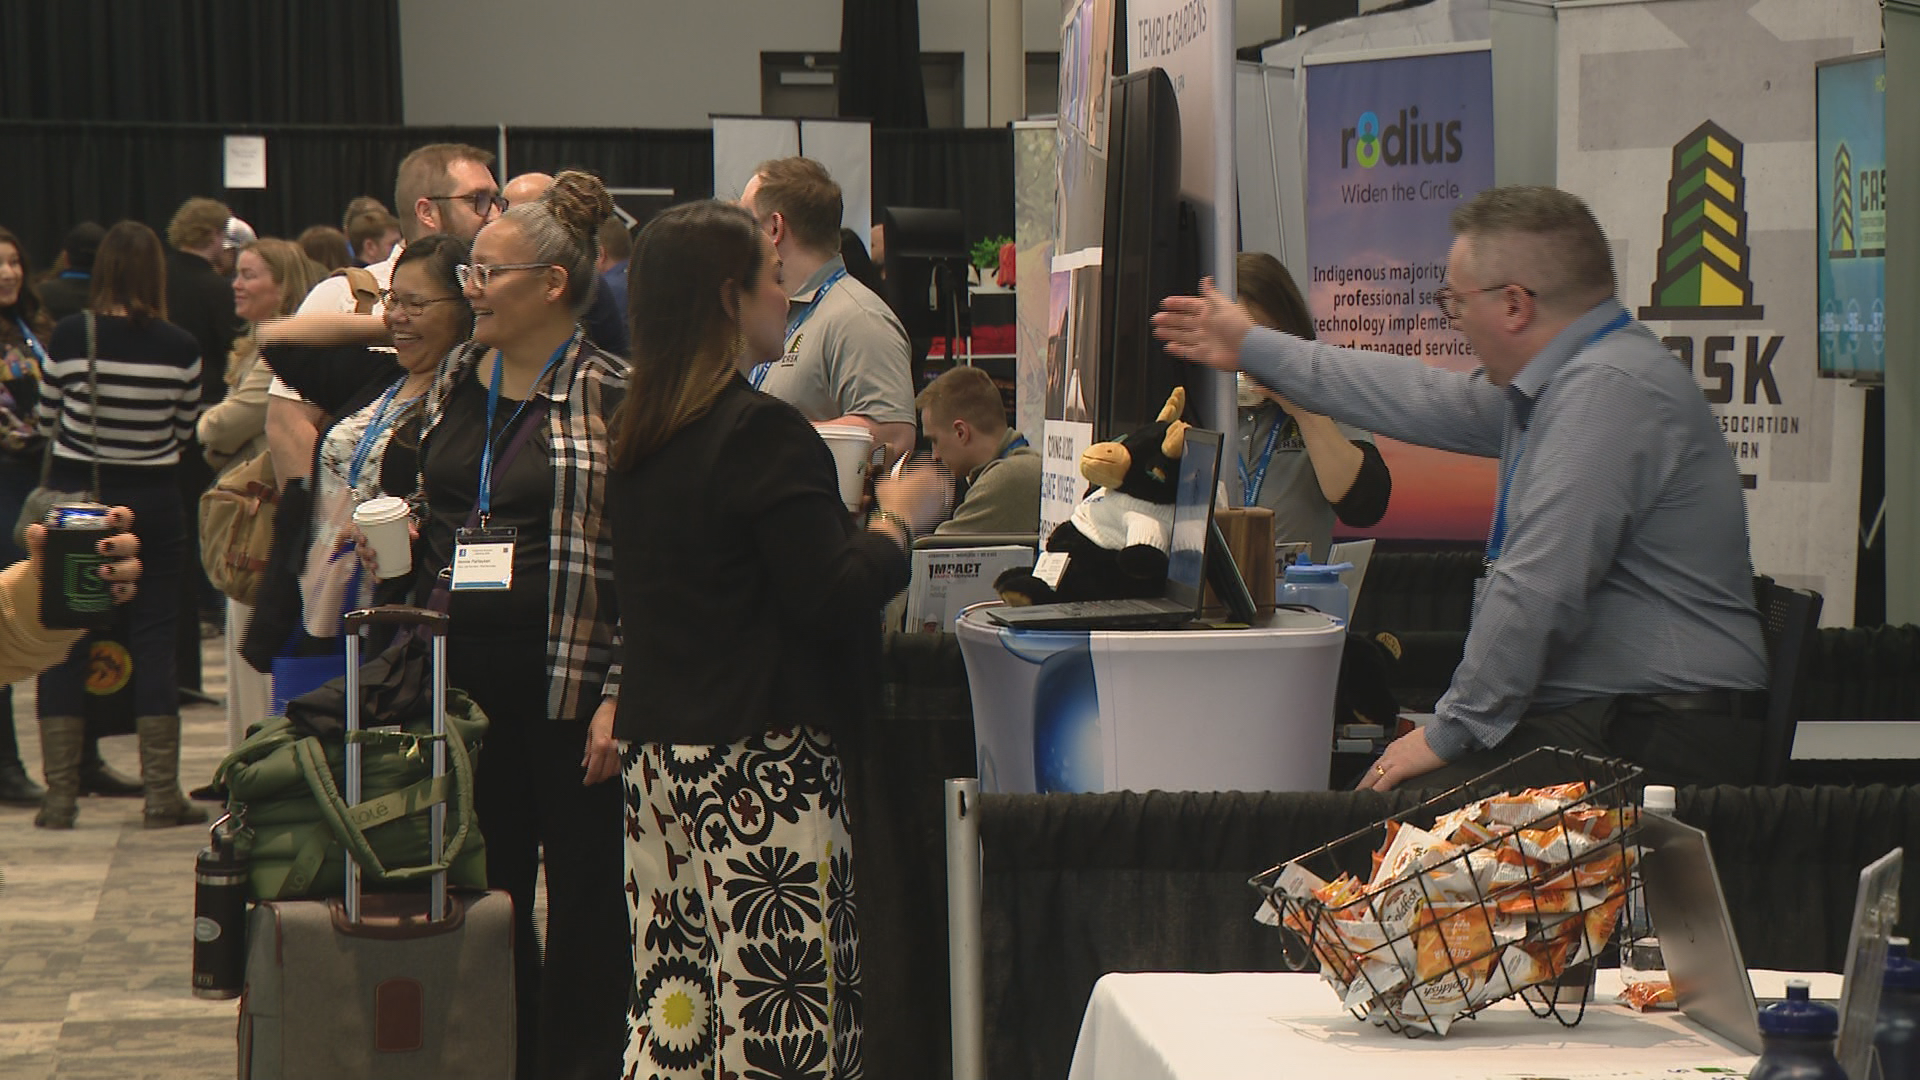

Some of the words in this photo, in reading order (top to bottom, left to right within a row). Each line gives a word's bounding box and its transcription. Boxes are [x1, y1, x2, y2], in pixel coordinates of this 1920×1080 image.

[1138, 14, 1172, 59] TEMPLE
[1173, 0, 1207, 51] GARDENS
[1341, 183, 1387, 204] Widen
[1392, 183, 1416, 202] the
[1313, 265, 1386, 286] Indigenous
[1389, 262, 1447, 284] majority
[1333, 288, 1414, 311] professional
[1313, 314, 1385, 336] technology
[1715, 416, 1799, 434] SOCIATION
[928, 562, 982, 581] IMPACT
[1424, 977, 1470, 996] Goldfish
